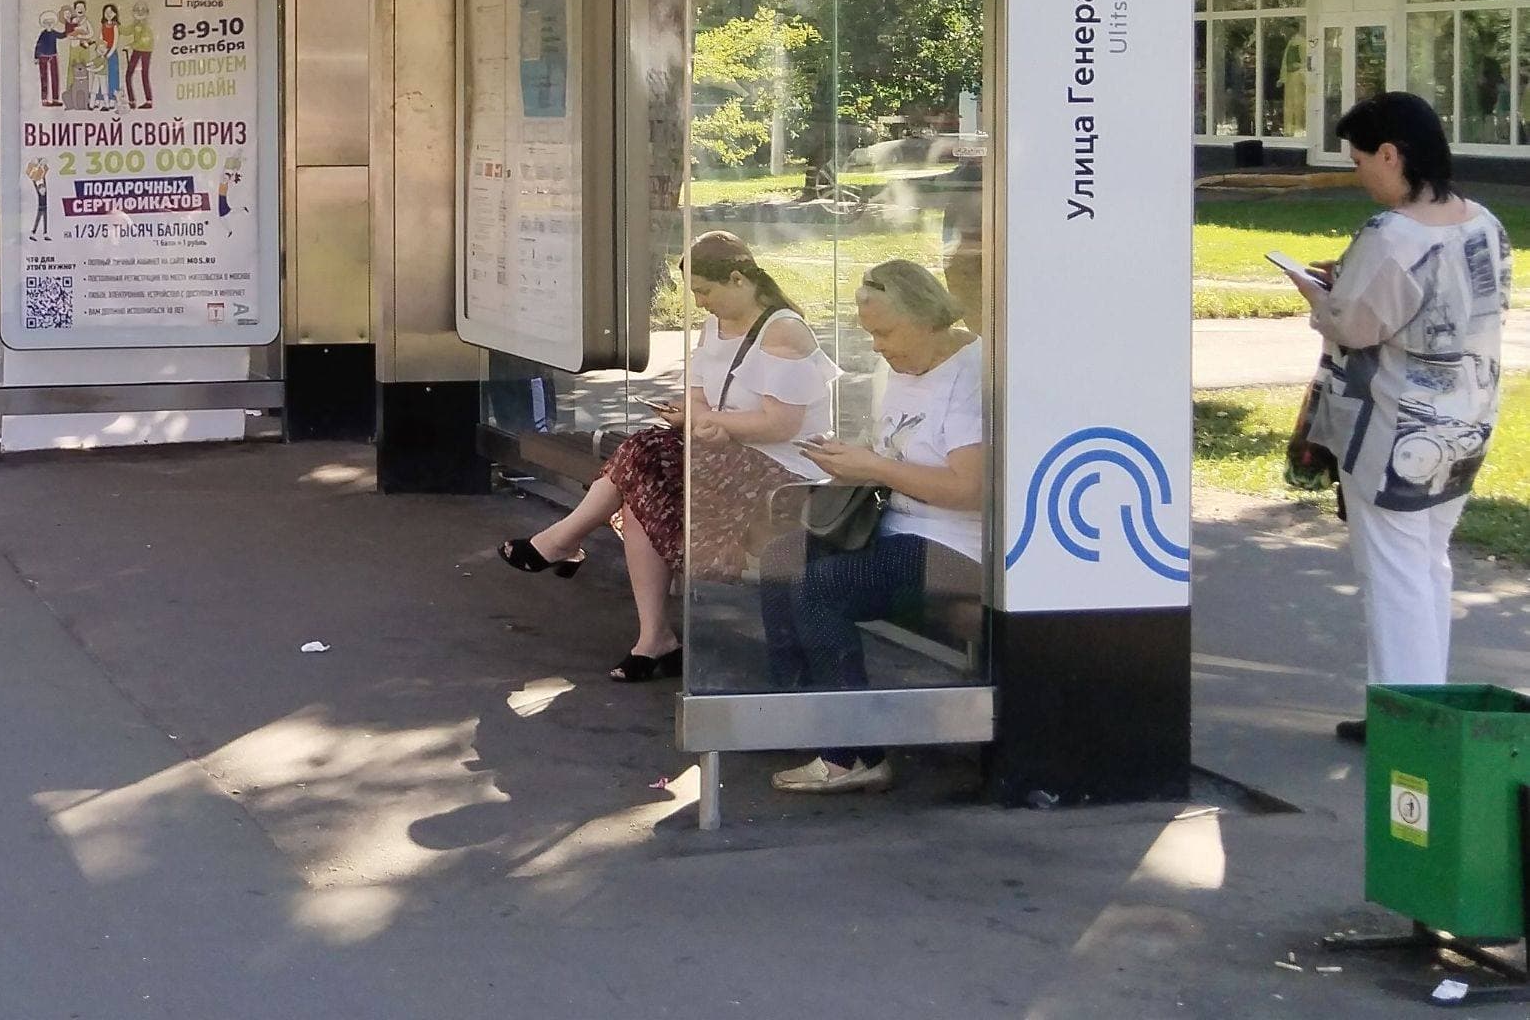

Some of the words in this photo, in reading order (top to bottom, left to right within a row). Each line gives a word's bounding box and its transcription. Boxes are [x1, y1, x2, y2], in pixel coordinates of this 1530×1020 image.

[171, 17, 245, 41] 8-9-10
[170, 39, 246, 56] сентября
[169, 55, 247, 78] ГОЛОСУЕМ
[175, 78, 236, 101] ОНЛАЙН
[24, 118, 123, 147] ВЫИГРАЙ
[131, 117, 185, 146] СВОЙ
[193, 121, 247, 145] ПРИЗ
[1067, 116, 1099, 220] Улица
[83, 180, 188, 197] ПОДАРОЧНЫХ
[72, 194, 203, 214] СЕРТИФИКАТОВ
[74, 223, 109, 239] 1/3/5
[113, 223, 154, 238] ТЫСЯЧ
